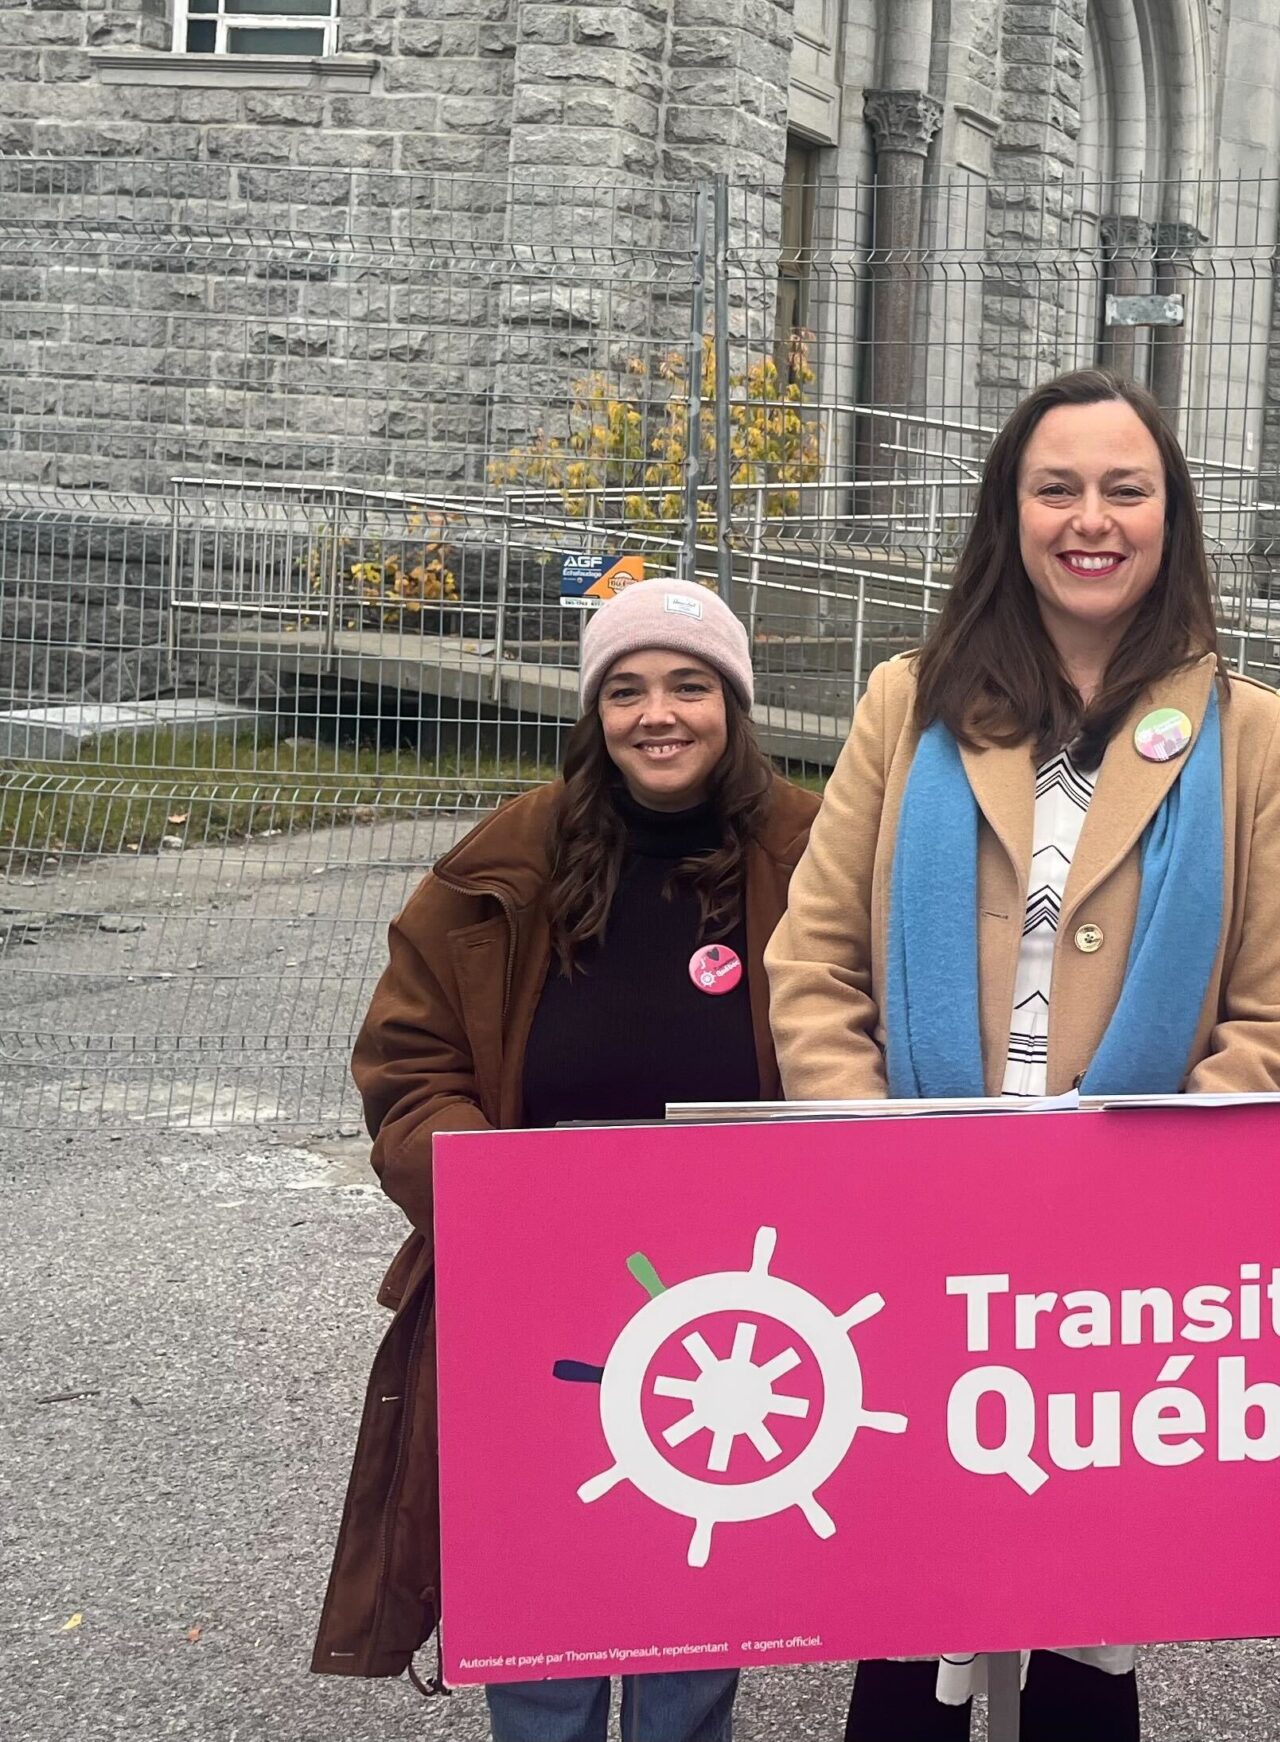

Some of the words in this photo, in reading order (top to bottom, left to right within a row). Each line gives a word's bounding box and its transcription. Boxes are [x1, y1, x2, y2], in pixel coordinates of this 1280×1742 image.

[563, 555, 603, 568] AGF
[459, 1655, 503, 1669] Autorisé
[505, 1655, 517, 1666] et
[518, 1653, 545, 1668] payé
[546, 1653, 564, 1666] par
[565, 1650, 608, 1662] Thomas
[608, 1646, 661, 1660] Vigneault,
[662, 1642, 729, 1657] représentant
[741, 1640, 752, 1651] et
[754, 1639, 785, 1653] agent
[786, 1635, 823, 1648] officiel.
